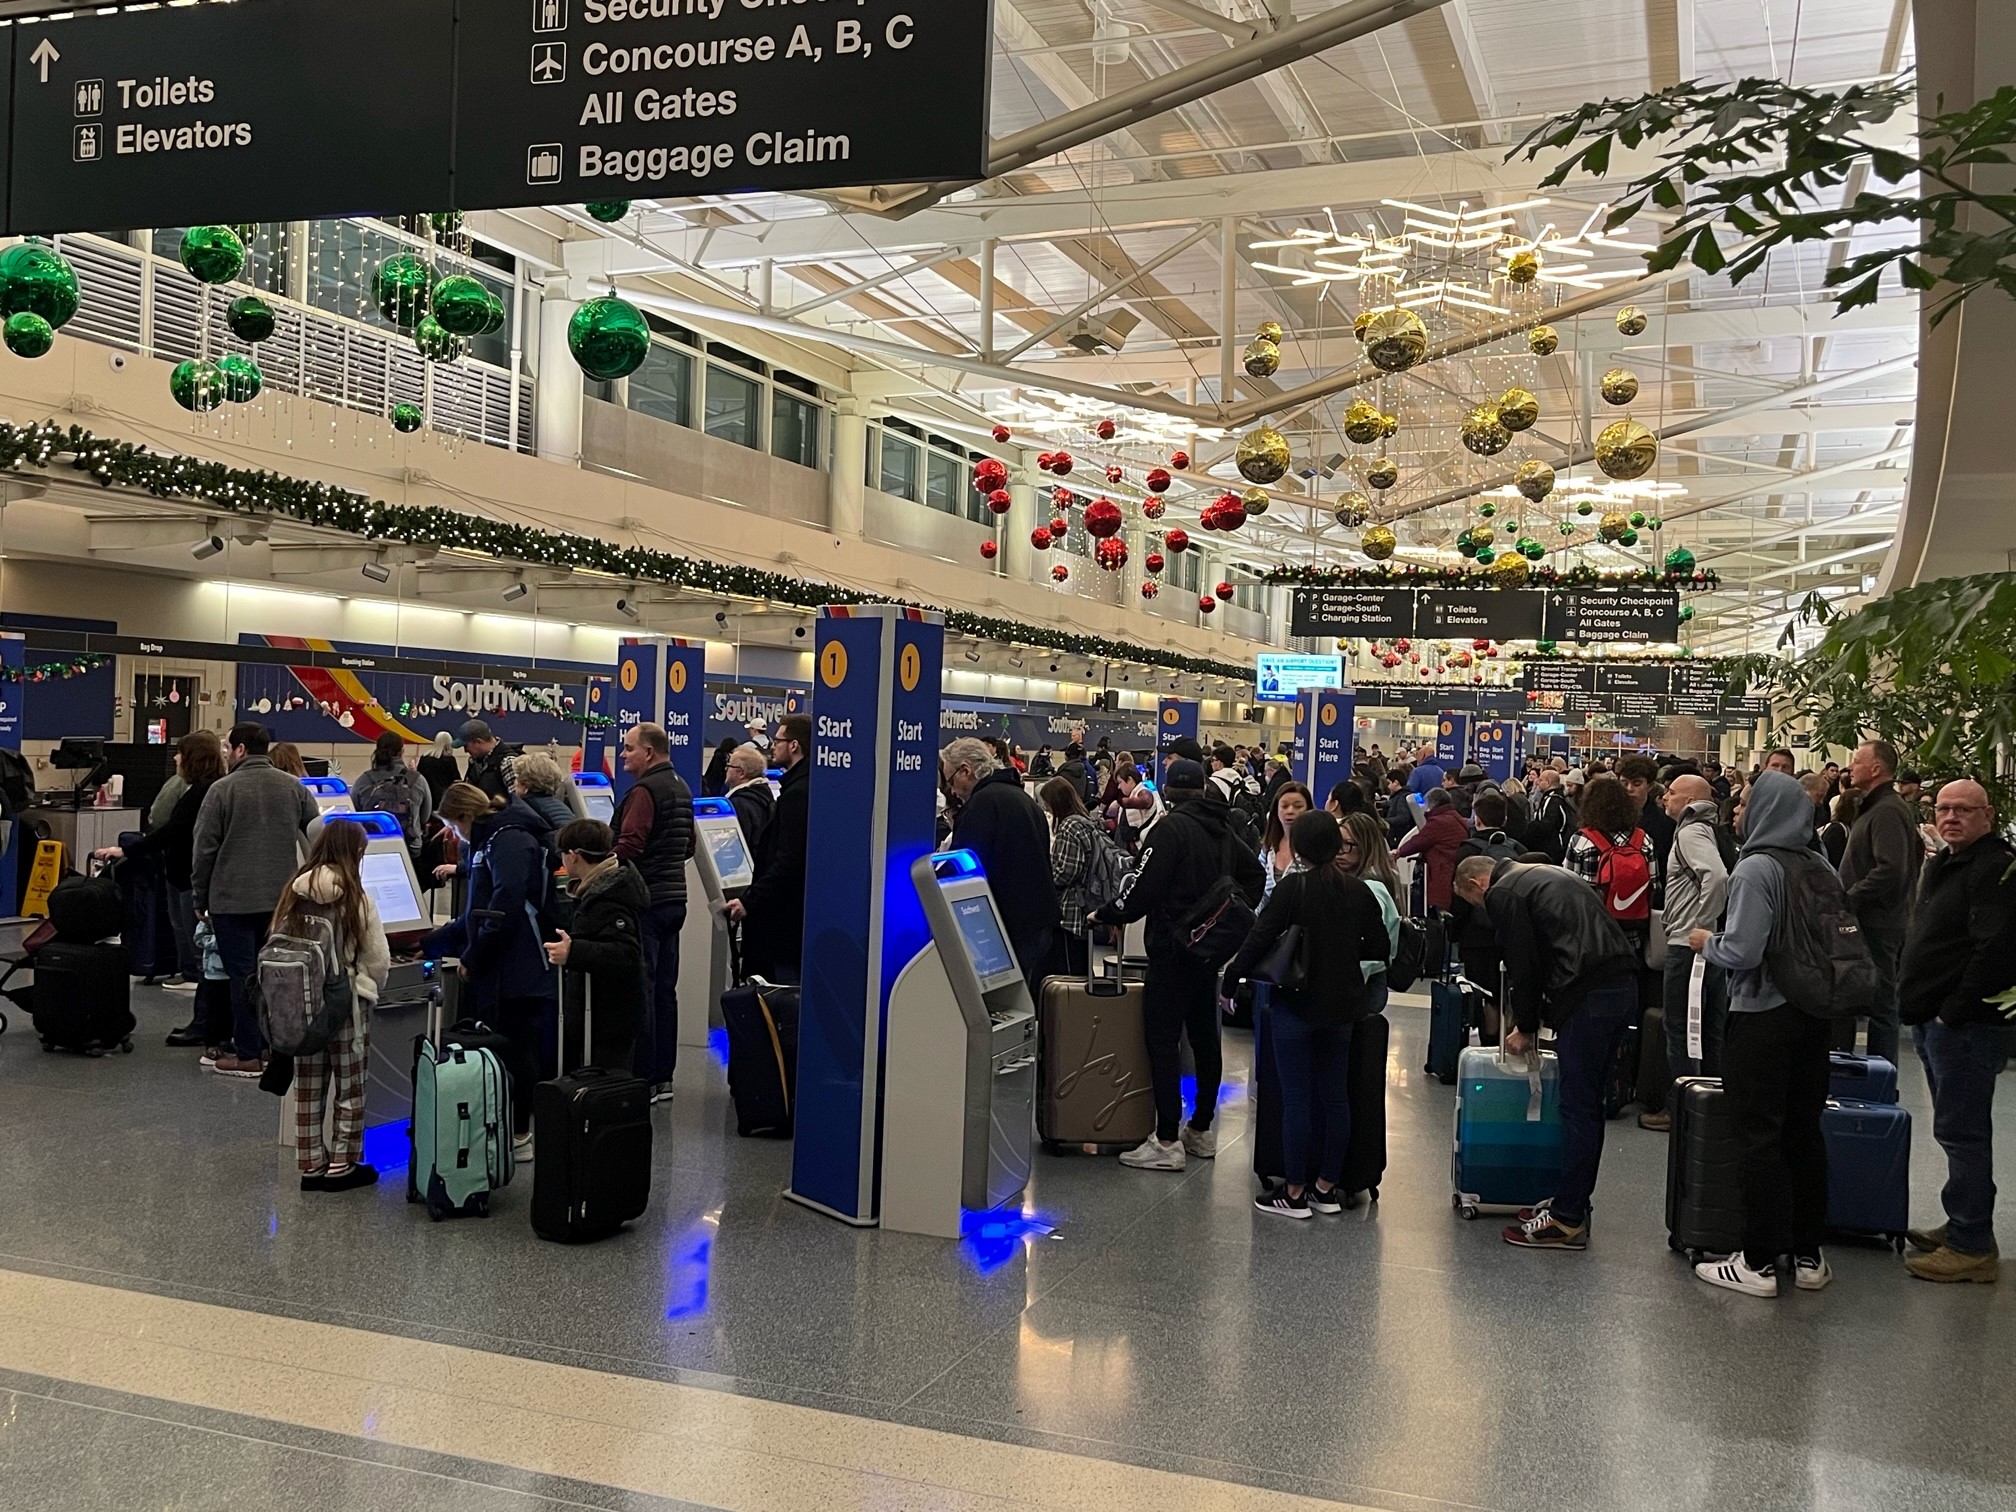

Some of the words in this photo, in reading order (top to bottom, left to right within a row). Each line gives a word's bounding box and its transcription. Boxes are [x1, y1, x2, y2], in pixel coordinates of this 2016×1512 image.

[583, 35, 775, 75] Concourse
[785, 24, 823, 62] A,
[836, 20, 872, 58] B,
[885, 14, 914, 49] C
[117, 76, 214, 108] Toilets
[579, 91, 622, 125] All
[634, 87, 737, 121] Gates
[116, 121, 252, 154] Elevators
[579, 142, 734, 182] Baggage
[745, 129, 850, 165] Claim
[1323, 594, 1384, 602] Garage-Center
[1580, 596, 1618, 606] Security
[1620, 596, 1673, 606] Checkpoint
[1322, 604, 1380, 612] Garage-South
[1447, 605, 1477, 613] Toilets
[1580, 608, 1630, 616] Concourse
[1632, 609, 1641, 617] A,
[1644, 609, 1653, 617] B,
[1322, 614, 1359, 622] Charging
[1362, 614, 1392, 622] Station
[1447, 616, 1488, 624] Elevators
[1580, 630, 1620, 640] Baggage
[1622, 631, 1649, 639] Claim
[140, 643, 150, 652] Bag
[150, 643, 163, 653] Drop
[830, 653, 836, 675] 1
[907, 656, 912, 678] 1
[627, 668, 631, 683] 1
[676, 670, 679, 684] 1
[433, 675, 562, 712] Southwest
[715, 694, 786, 723] Southwe
[620, 709, 640, 724] Start
[668, 711, 689, 726] Start
[940, 709, 978, 730] uthwest
[818, 716, 852, 738] Start
[897, 720, 922, 741] Start
[668, 731, 688, 745] Here
[1162, 732, 1182, 740] Star
[1320, 738, 1339, 748] Start
[1440, 743, 1454, 751] Start
[817, 745, 851, 768] Here
[896, 750, 921, 771] Here
[1319, 752, 1338, 762] Here
